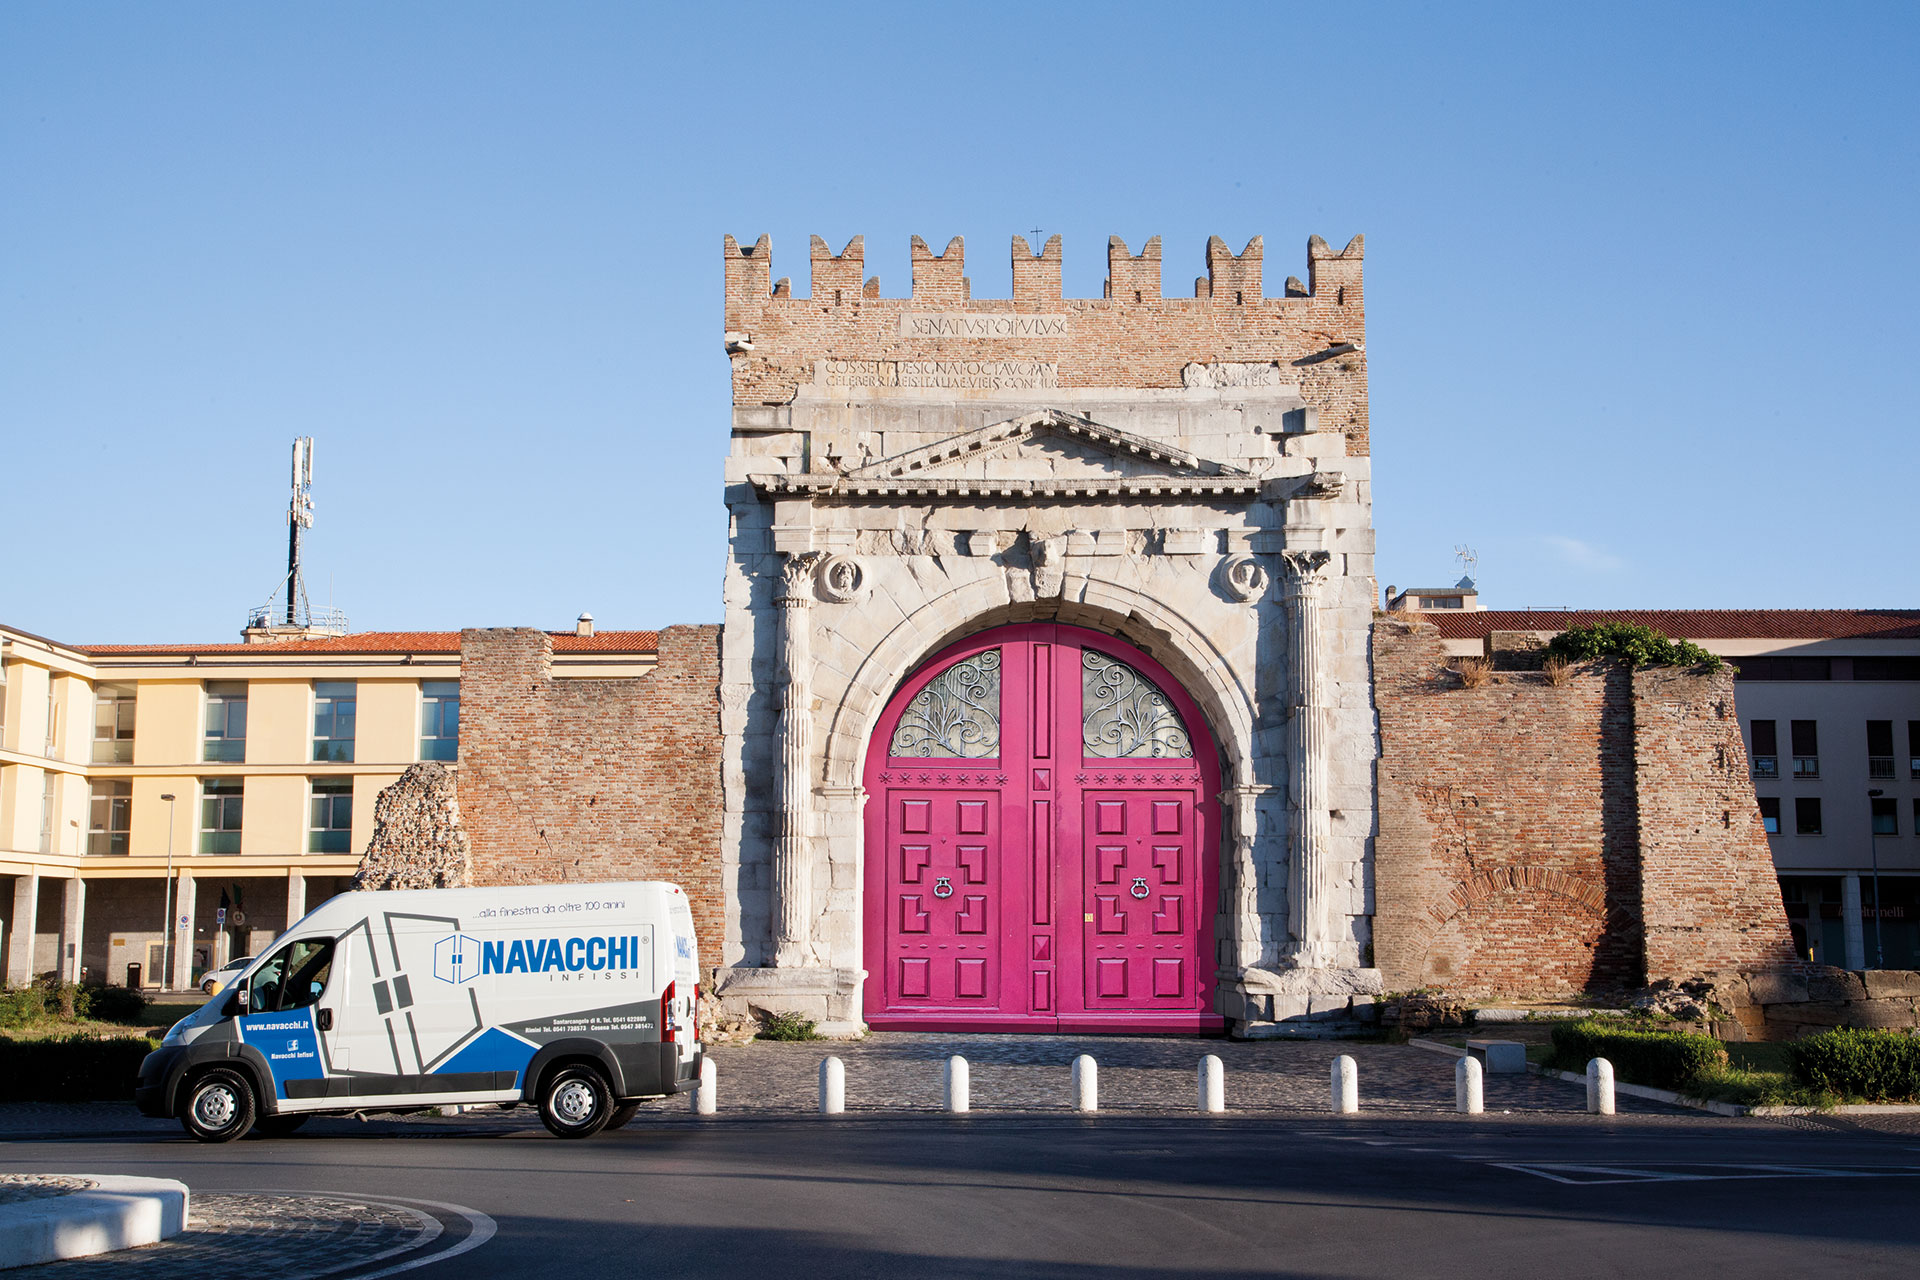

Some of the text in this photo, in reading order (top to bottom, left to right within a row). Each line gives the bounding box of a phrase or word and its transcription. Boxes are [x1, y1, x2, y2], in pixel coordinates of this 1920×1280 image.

[499, 905, 539, 917] finestra
[542, 904, 556, 915] da
[558, 902, 582, 912] oltre
[585, 901, 600, 911] 100
[603, 900, 625, 910] anni
[482, 936, 638, 975] NAVACCHI
[550, 971, 639, 982] INFISSI
[246, 1021, 309, 1031] www.navacchi.it
[271, 1052, 296, 1060] Navacchi
